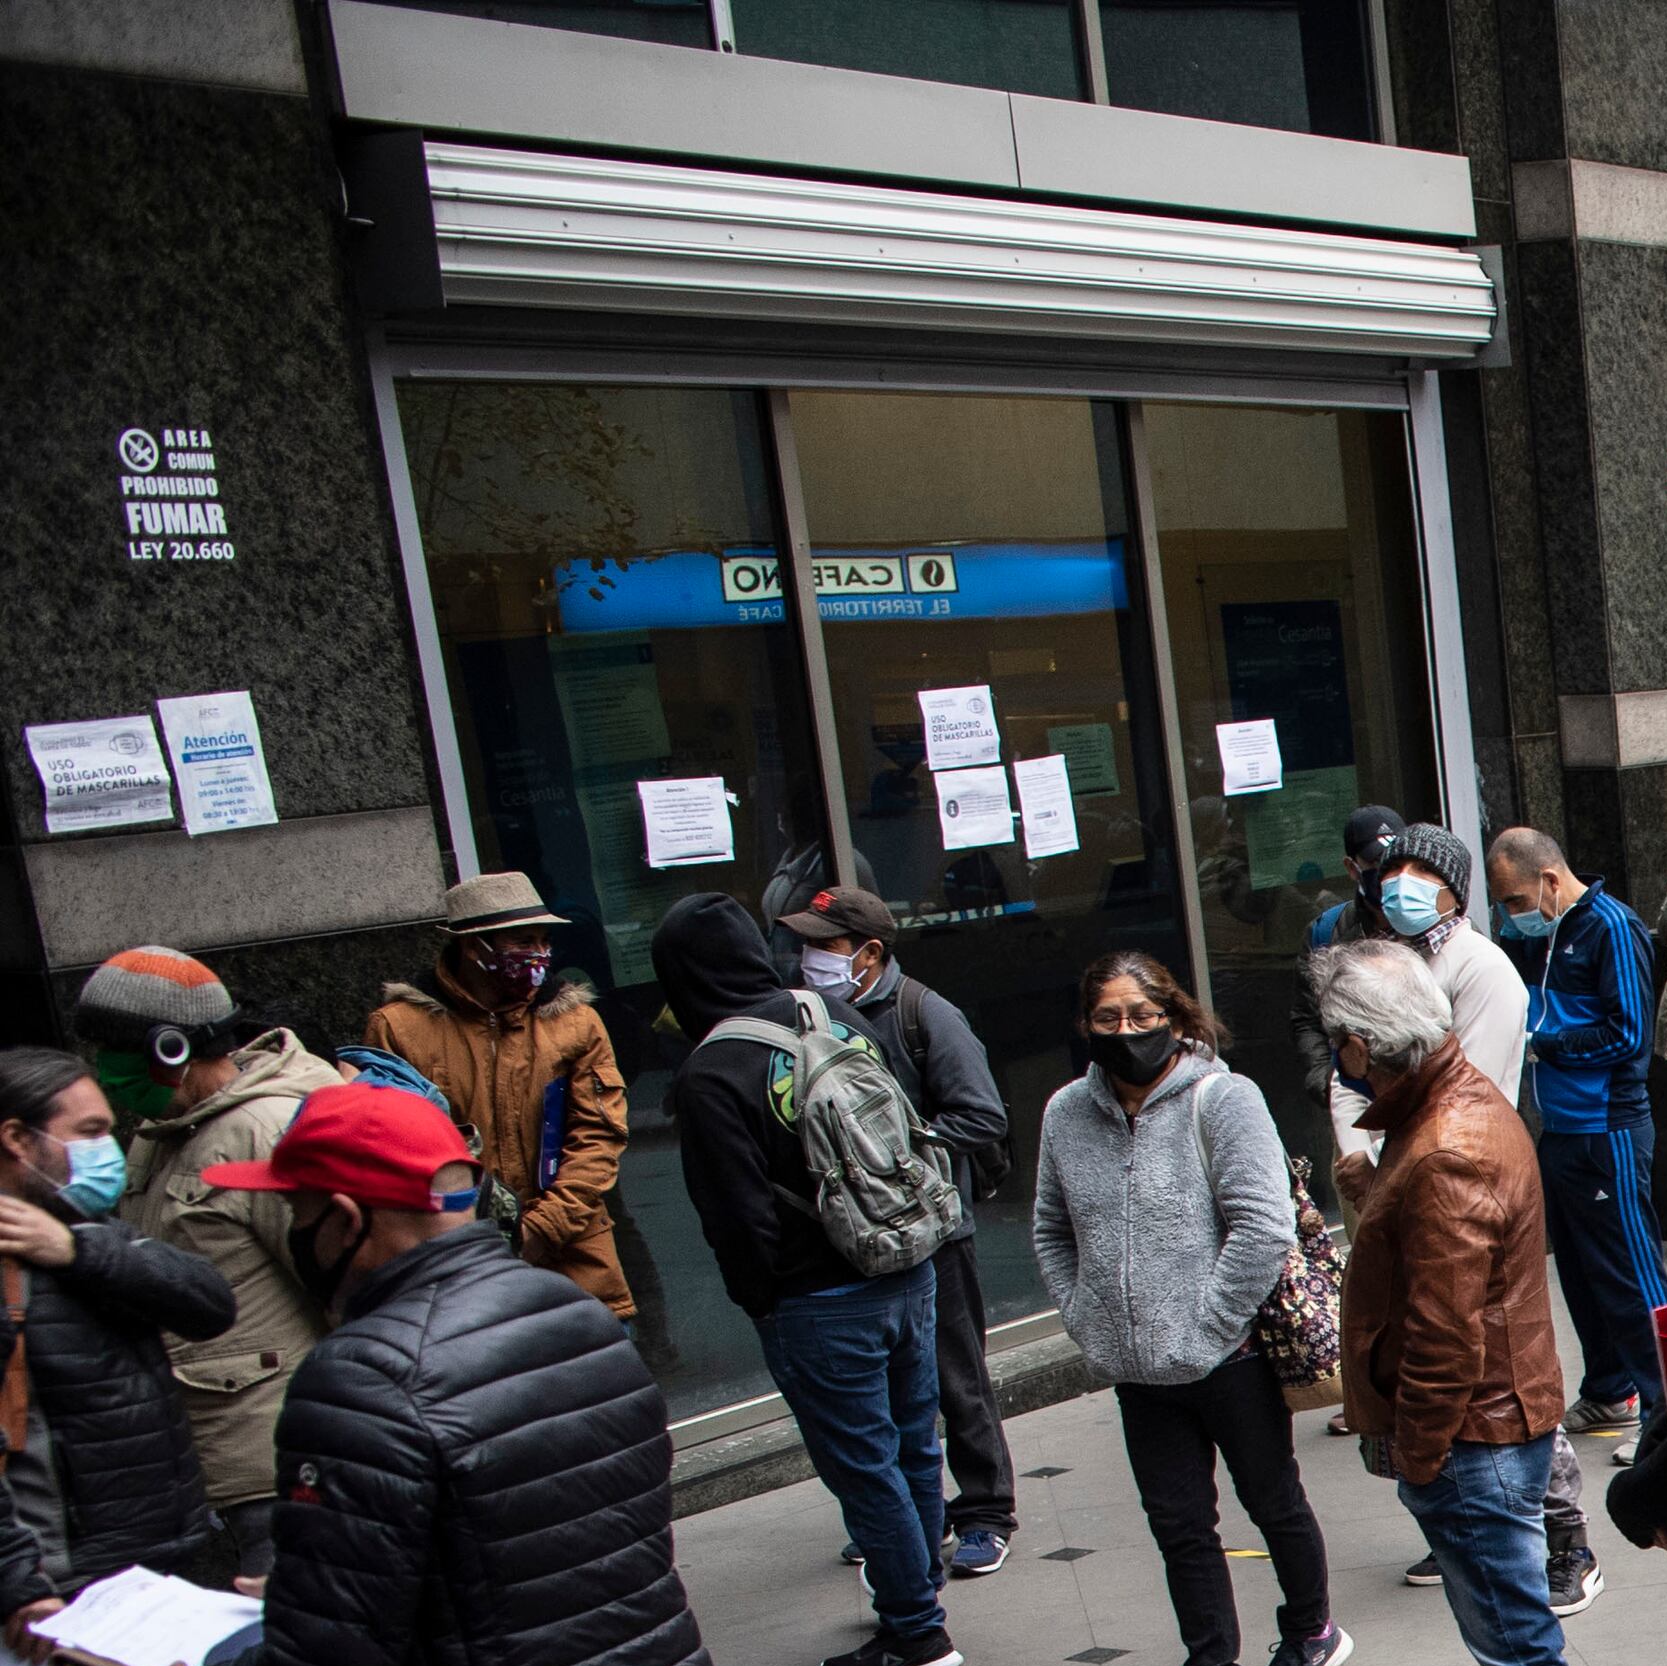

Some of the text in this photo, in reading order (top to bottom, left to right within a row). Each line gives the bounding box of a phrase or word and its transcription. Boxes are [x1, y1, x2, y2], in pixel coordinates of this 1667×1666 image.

[164, 429, 212, 447] AREA
[168, 452, 215, 470] COMUN
[121, 476, 219, 496] PROHIBIDO
[126, 502, 228, 534] FUMAR
[129, 541, 235, 560] LEY 20.660
[931, 714, 947, 724] USO
[932, 720, 981, 733] OBLIGATORIO
[184, 730, 247, 750] Atención
[933, 729, 993, 743] DE MASCARILLAS
[48, 759, 74, 771] USO
[53, 765, 137, 784] OBLIGATORIO
[56, 775, 160, 797] DE MASCARILLAS
